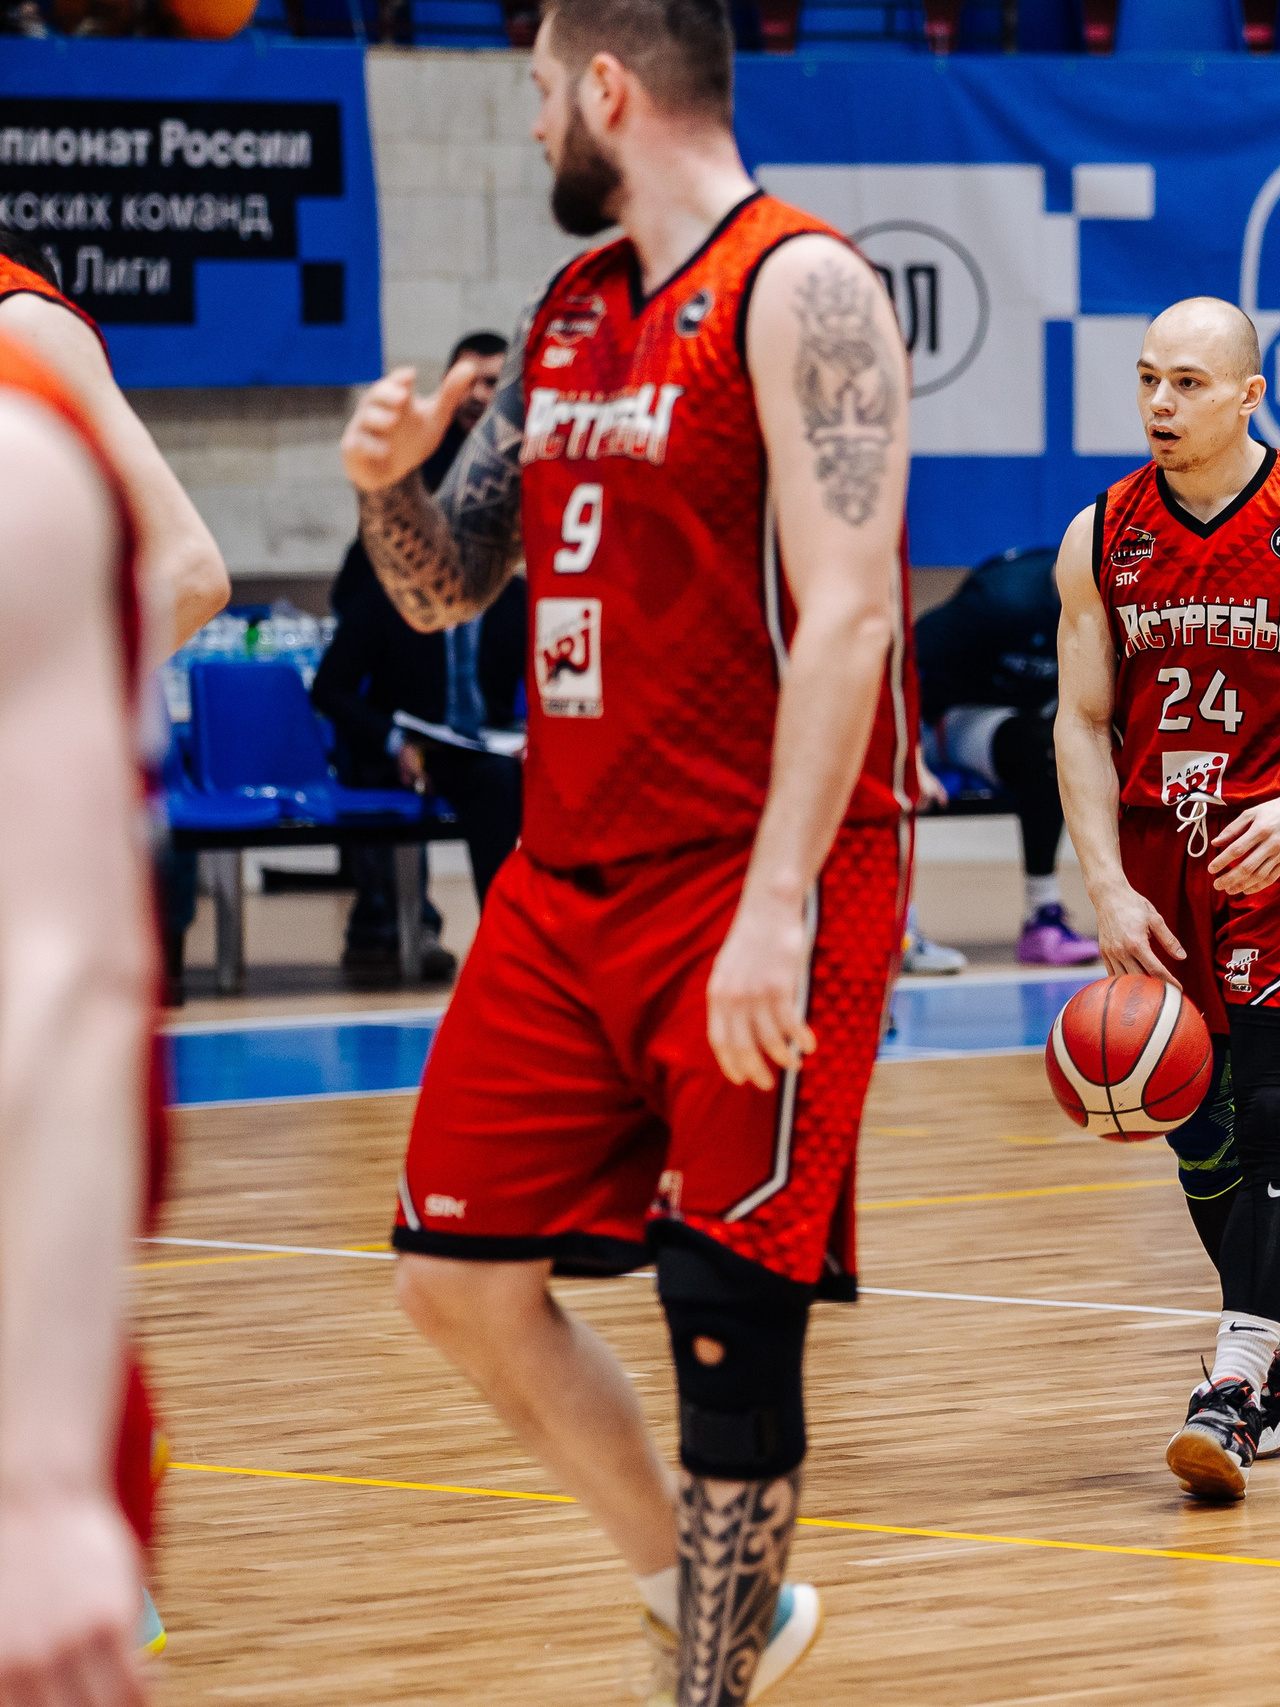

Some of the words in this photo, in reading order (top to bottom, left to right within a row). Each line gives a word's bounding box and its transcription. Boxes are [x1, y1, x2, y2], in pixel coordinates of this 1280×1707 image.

[0, 127, 152, 167] пионат
[160, 117, 313, 168] России
[120, 192, 274, 242] команд
[72, 246, 171, 294] Лиги
[553, 482, 604, 575] 9
[1115, 569, 1141, 586] STK
[1157, 667, 1243, 732] 24
